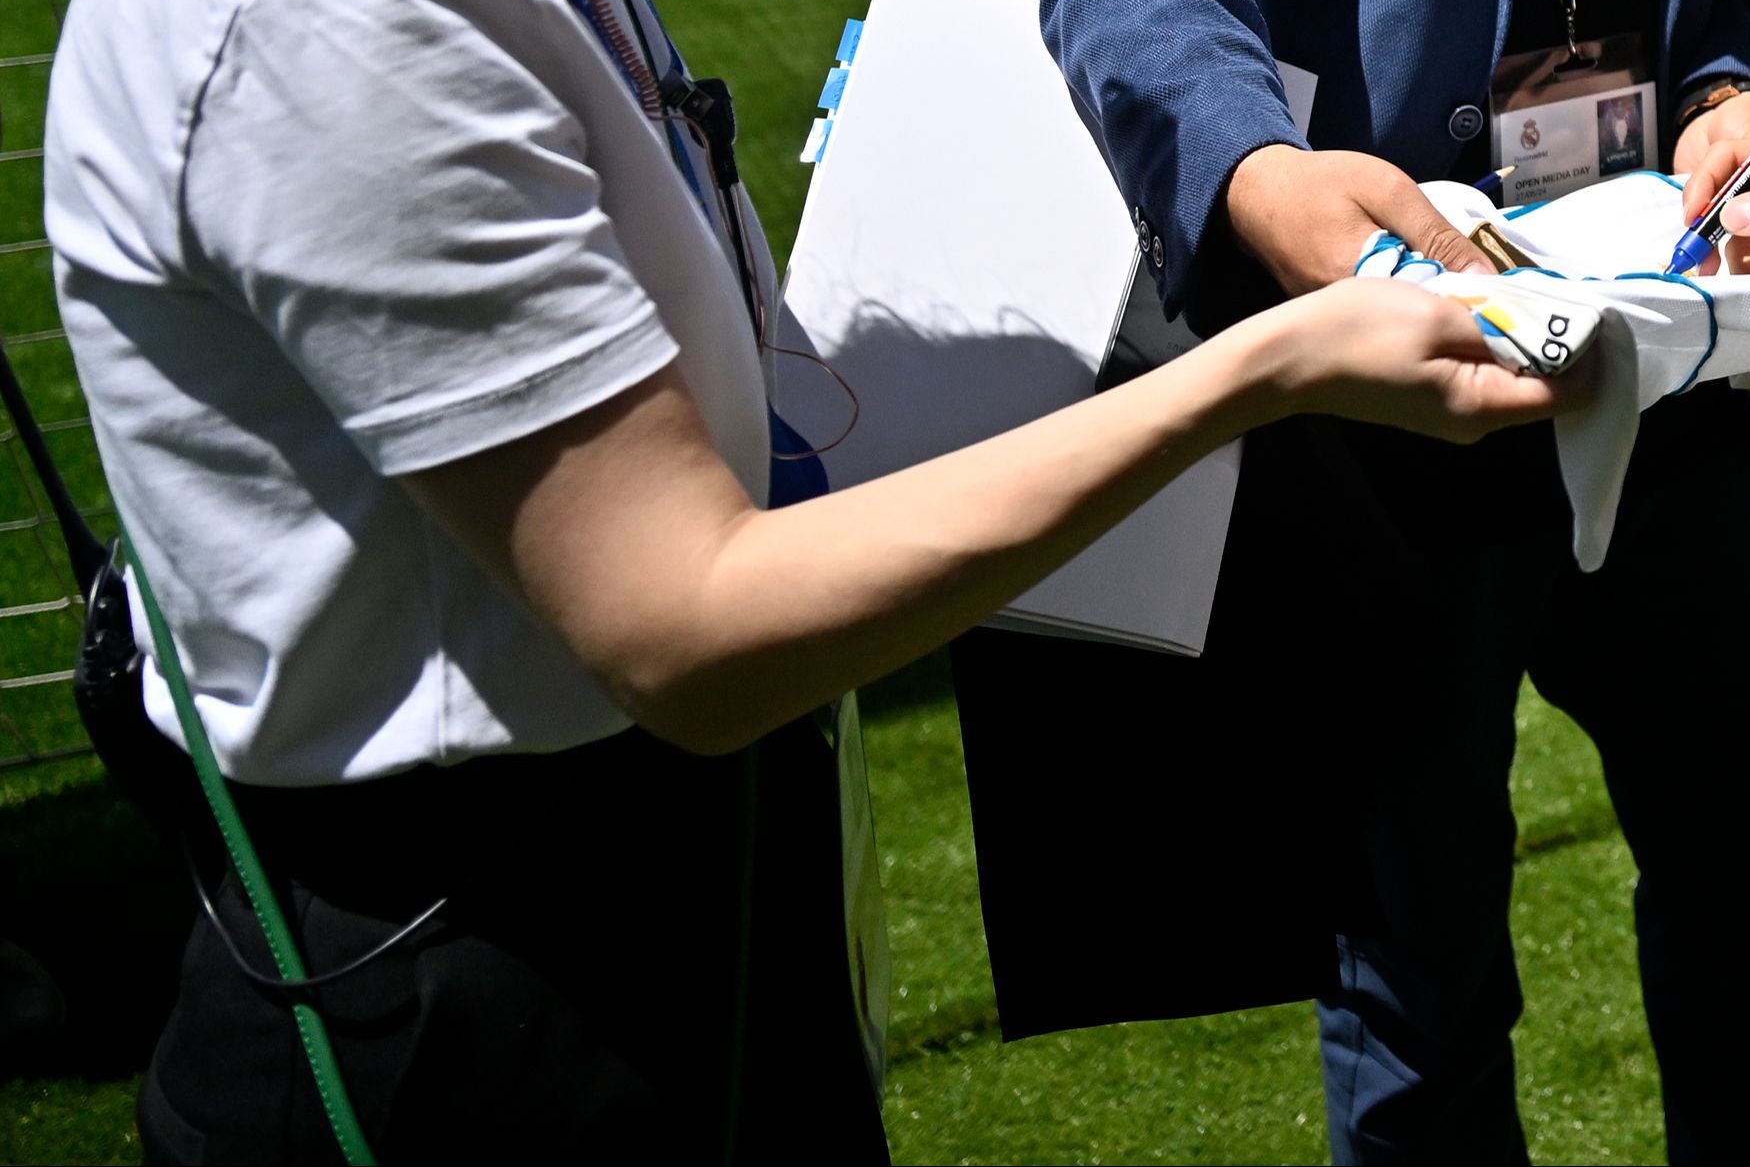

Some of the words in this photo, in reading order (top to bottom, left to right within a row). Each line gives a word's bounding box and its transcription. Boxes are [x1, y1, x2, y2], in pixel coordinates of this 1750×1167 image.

[1515, 176, 1541, 191] OPEN
[1542, 169, 1572, 184] MEDIA
[1573, 165, 1592, 179] DAY
